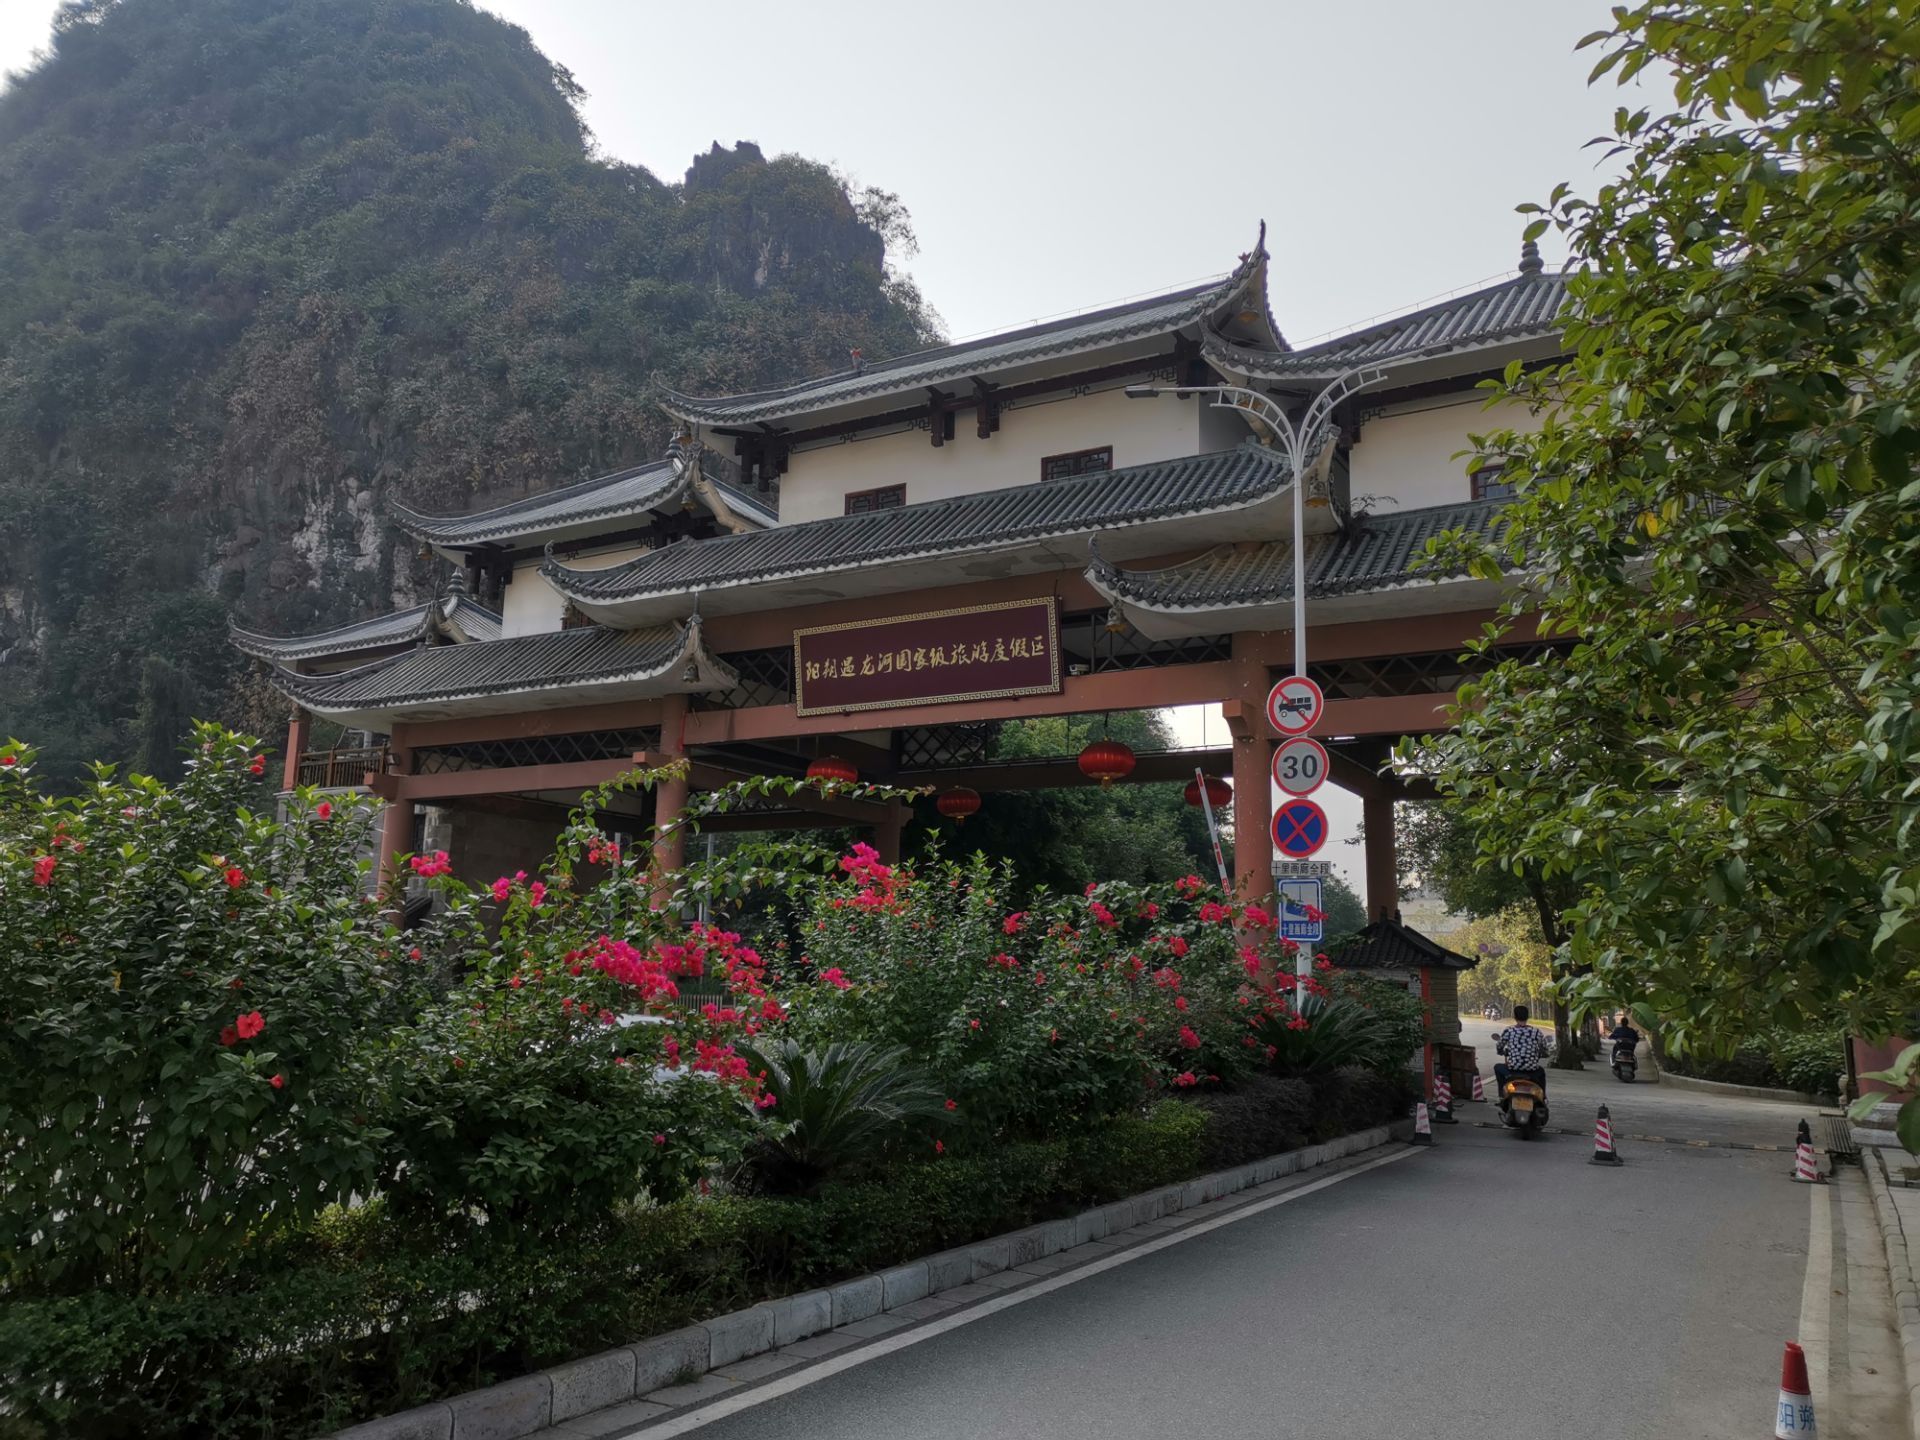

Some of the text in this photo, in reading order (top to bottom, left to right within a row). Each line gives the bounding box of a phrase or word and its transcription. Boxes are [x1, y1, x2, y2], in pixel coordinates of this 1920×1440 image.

[805, 635, 1045, 681] 阳朔遇龙河国家级旅游度假区
[1283, 755, 1318, 779] 30
[1272, 862, 1329, 875] 十里画廊全段
[1283, 923, 1319, 936] 十里画廊全段
